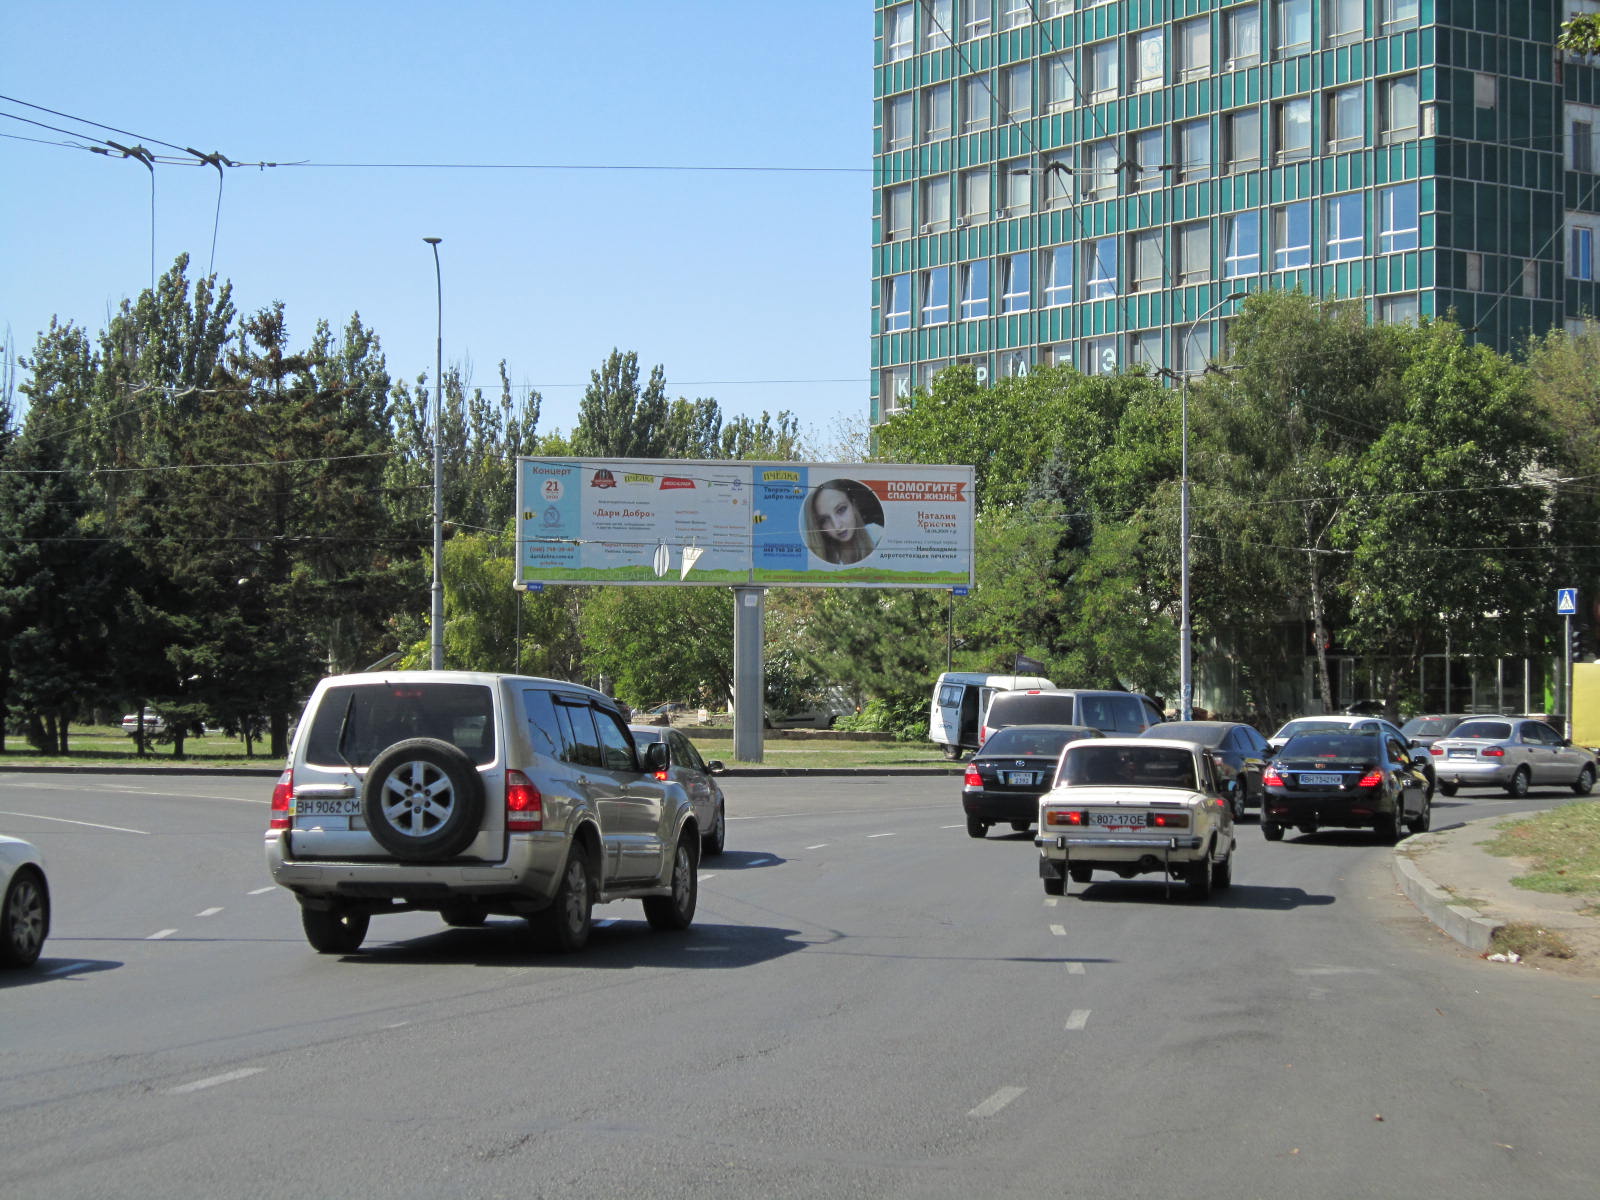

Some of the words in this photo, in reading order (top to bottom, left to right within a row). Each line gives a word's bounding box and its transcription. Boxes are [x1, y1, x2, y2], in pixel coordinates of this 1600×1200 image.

[532, 466, 572, 476] Концерт
[545, 481, 560, 492] 21
[887, 482, 957, 494] ПОМОГИТЕ
[887, 492, 922, 501] СПАСТИ
[924, 493, 958, 502] ЖИЗНЬ!
[917, 511, 957, 521] Наталия
[296, 801, 314, 813] BH
[316, 801, 341, 813] 9062
[344, 801, 360, 813] CM
